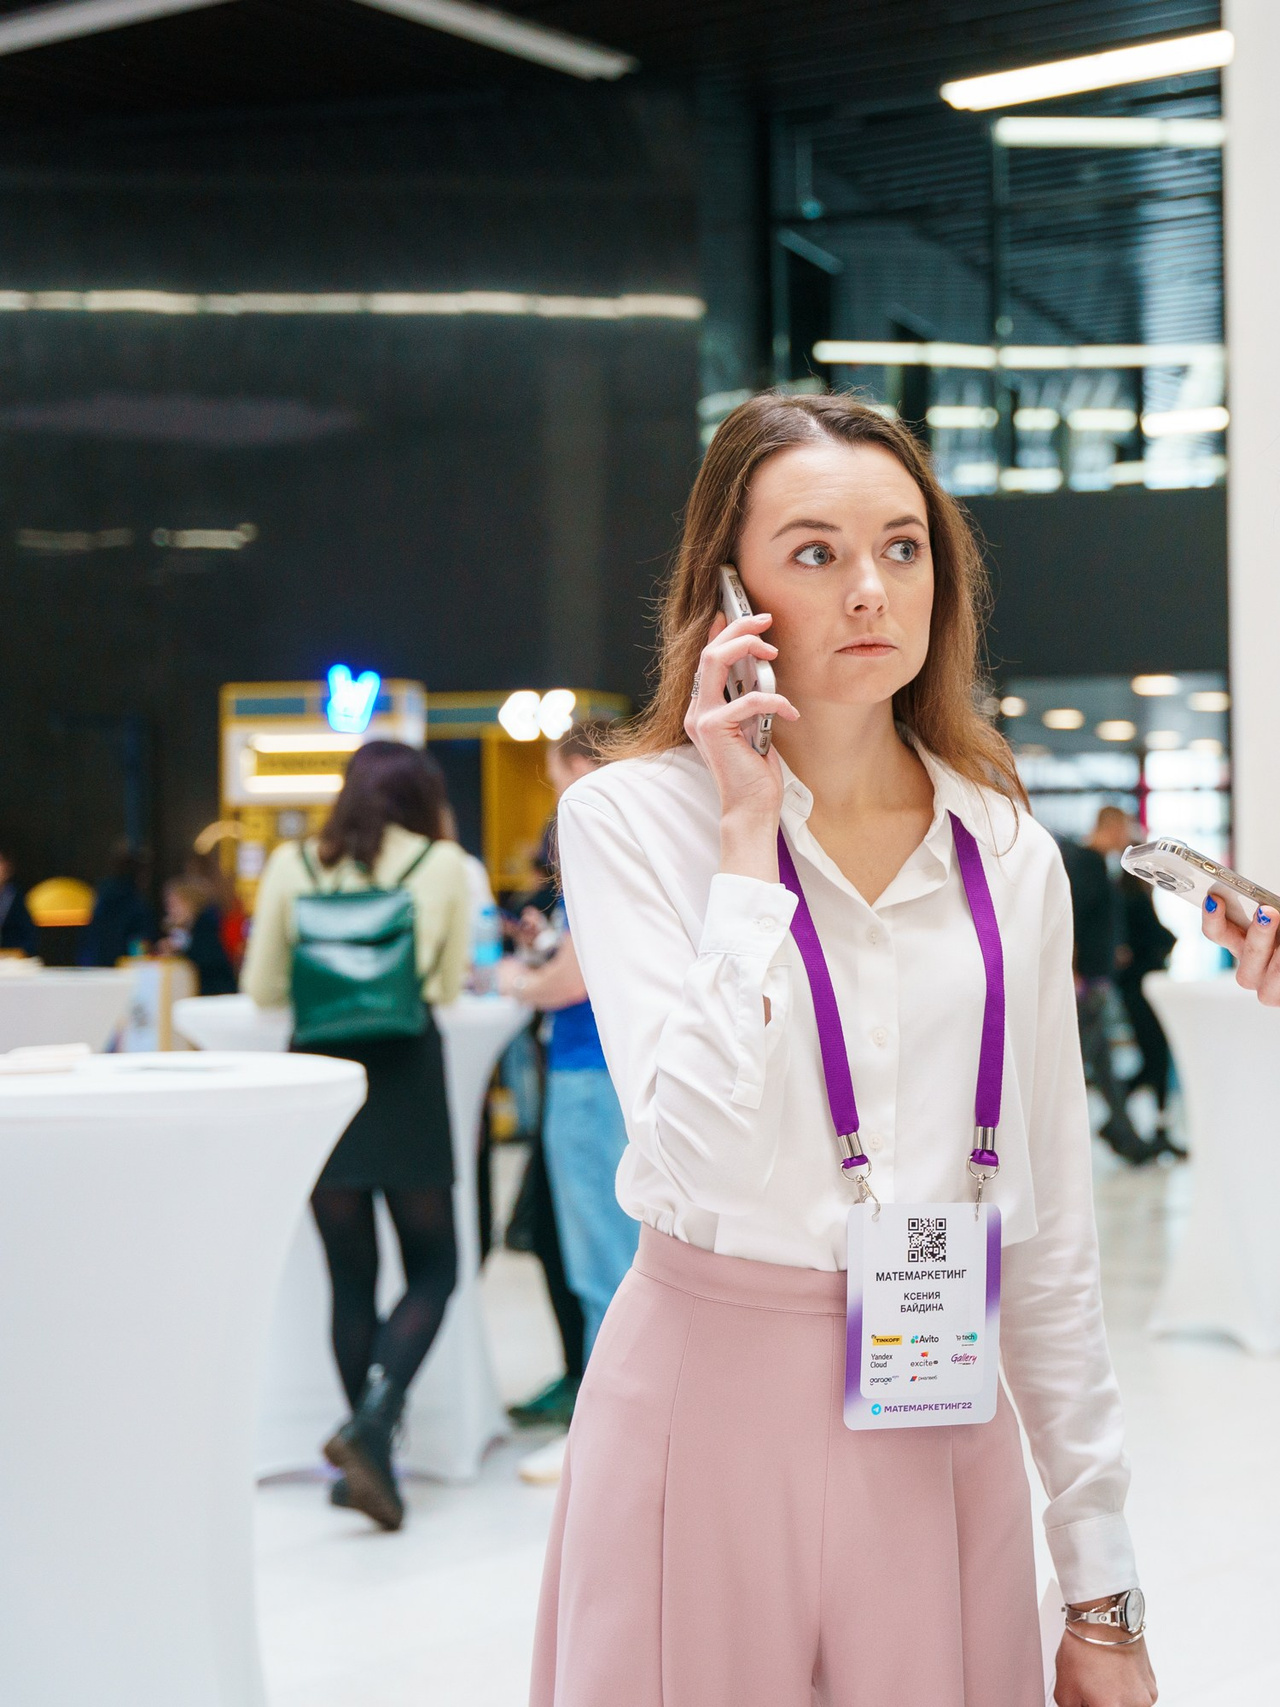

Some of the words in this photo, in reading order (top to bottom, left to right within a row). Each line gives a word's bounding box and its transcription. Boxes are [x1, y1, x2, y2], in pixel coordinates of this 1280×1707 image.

[875, 1268, 968, 1282] МАТЕМАРКЕТИНГ
[903, 1291, 941, 1301] КСЕНИЯ
[900, 1302, 944, 1313] БАЙДИНА
[919, 1334, 940, 1344] Avito
[961, 1332, 975, 1341] tech
[870, 1353, 893, 1361] Yandex
[950, 1352, 978, 1365] Gallery
[869, 1361, 888, 1369] Cloud
[910, 1359, 934, 1367] excite
[869, 1376, 893, 1386] garage
[884, 1401, 973, 1413] МАТЕМАРКЕТИНГ22
